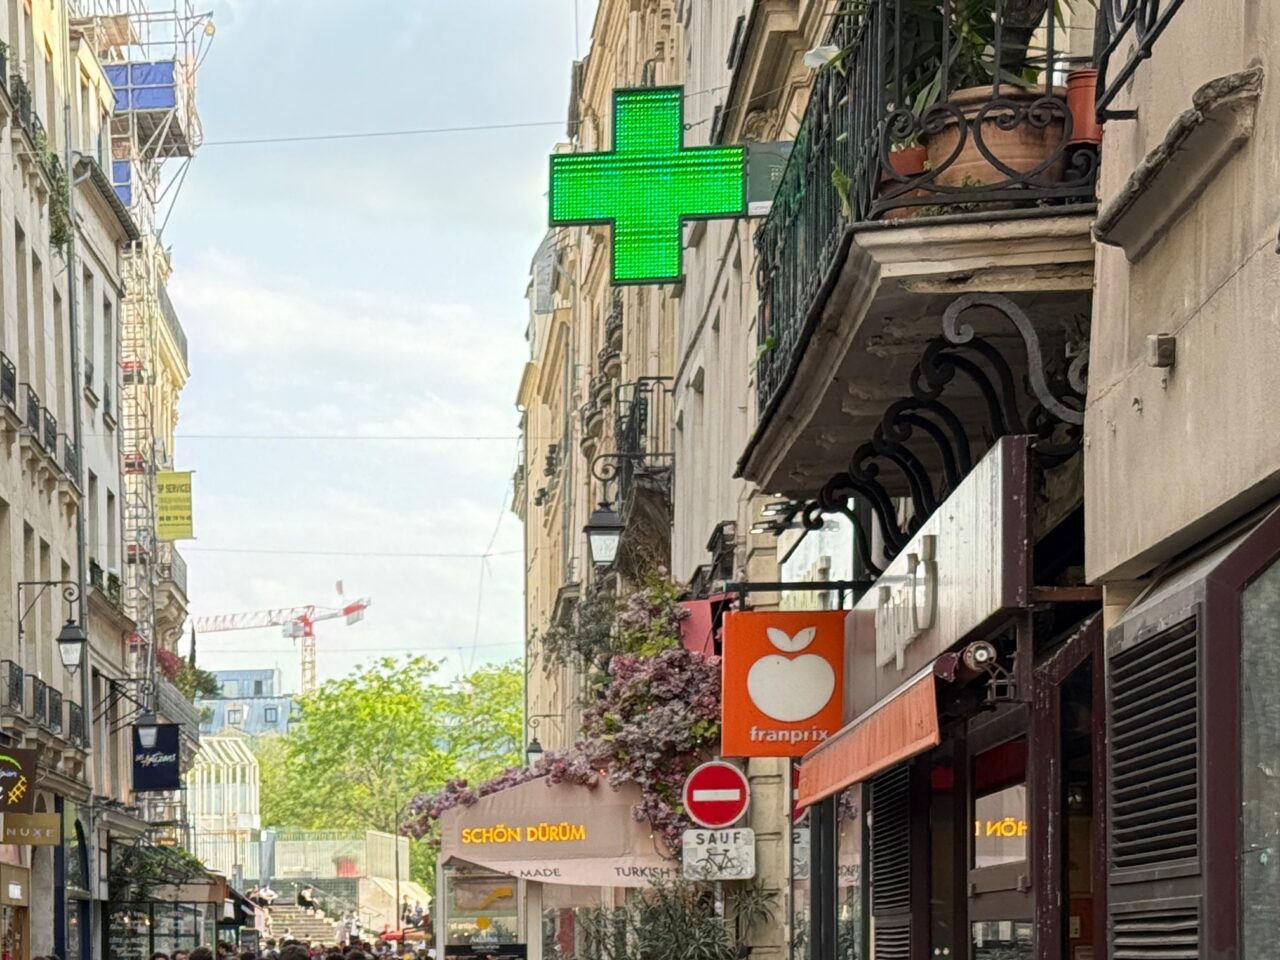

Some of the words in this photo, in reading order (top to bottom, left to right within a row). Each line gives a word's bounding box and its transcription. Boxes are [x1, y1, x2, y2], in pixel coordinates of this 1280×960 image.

[750, 726, 830, 744] franprix
[6, 828, 55, 838] NUXE
[461, 824, 521, 844] SCHÖN
[526, 822, 586, 841] DÜRÜM
[696, 831, 741, 844] SAUF
[520, 868, 562, 878] MADE
[614, 866, 670, 879] TURKISH
